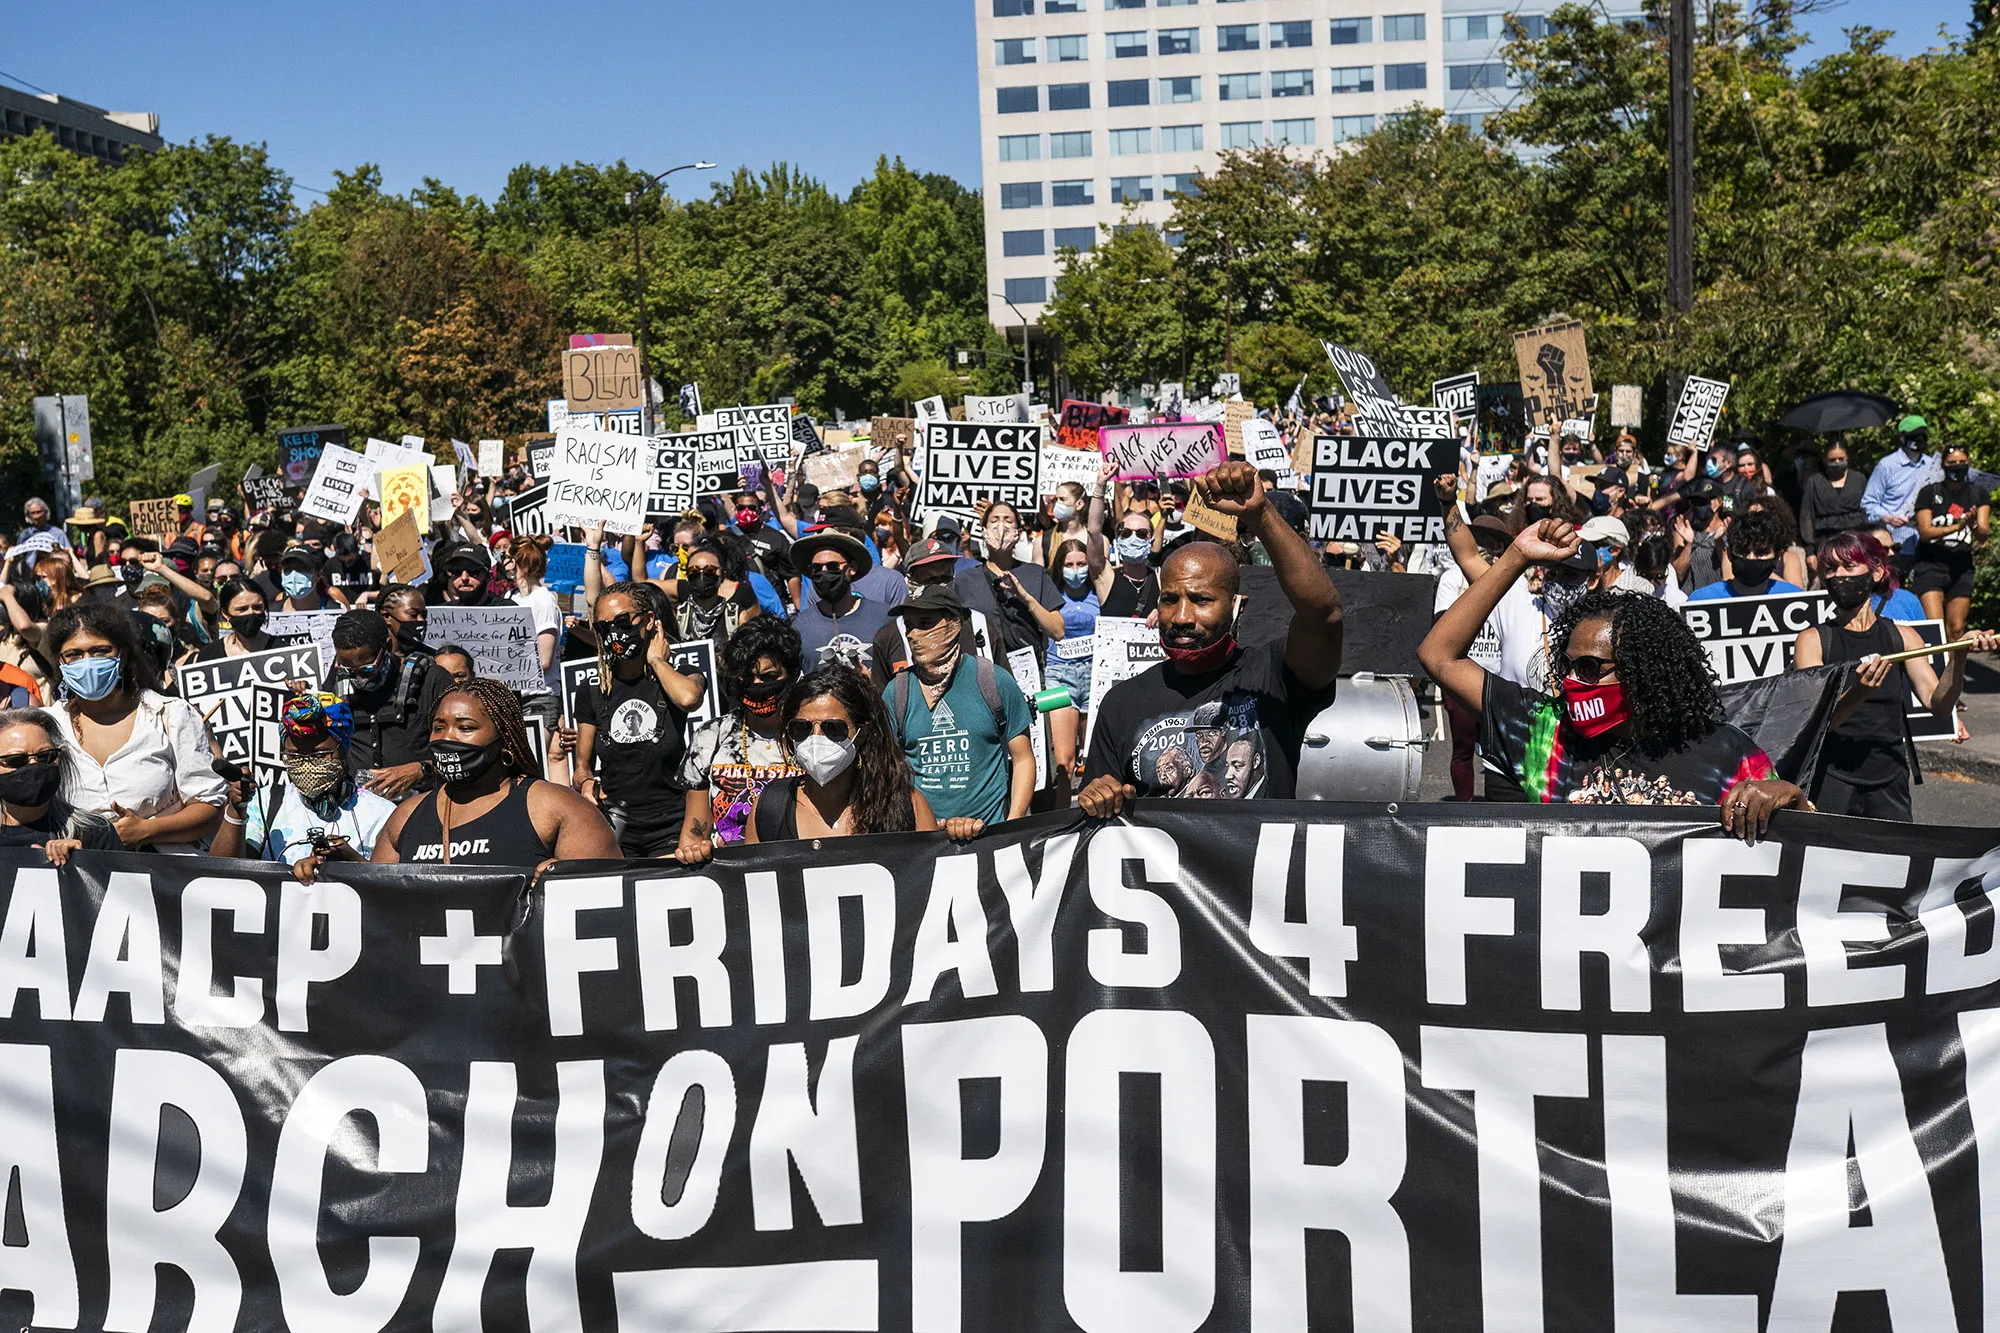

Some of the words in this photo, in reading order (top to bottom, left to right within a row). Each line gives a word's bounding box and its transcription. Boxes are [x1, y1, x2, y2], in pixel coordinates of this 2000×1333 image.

[1326, 343, 1376, 380] COVID
[569, 352, 639, 401] BLM
[1350, 376, 1362, 393] IS
[1367, 381, 1378, 396] A
[1436, 384, 1475, 411] VOTE
[978, 398, 1015, 416] STOP
[1671, 380, 1699, 440] BLACK
[1684, 385, 1711, 440] LIVES
[595, 415, 640, 435] VOTE
[719, 408, 787, 427] BLACK
[872, 418, 912, 432] BLACK
[1402, 411, 1448, 425] ACK
[1698, 386, 1724, 447] MATTER
[283, 432, 319, 448] KEEP
[659, 432, 731, 451] RACISM
[738, 426, 786, 445] IVES
[872, 438, 895, 446] MATT
[930, 427, 1037, 450] BLACK
[567, 437, 637, 470] RACISM
[738, 444, 789, 461] ATTER
[1043, 453, 1061, 461] WE
[1143, 431, 1178, 476] LIVES
[1257, 449, 1283, 460] LIVES
[1316, 439, 1434, 468] BLACK
[336, 460, 357, 473] BLACK
[590, 468, 603, 481] IS
[933, 454, 1033, 480] LIVES
[1061, 463, 1100, 473] TREND
[243, 478, 281, 494] BLACK
[325, 478, 353, 494] LIVES
[1317, 478, 1416, 504] LIVES
[256, 497, 297, 509] MATTER
[553, 479, 642, 515] TERRORISM
[928, 484, 1034, 507] MATTER
[139, 502, 176, 513] FUCK
[314, 497, 350, 513] MATTER
[133, 512, 174, 526] POLICE
[607, 520, 637, 532] POLICE
[134, 521, 181, 537] BRUTALITY
[1309, 514, 1447, 542] MATTER
[385, 545, 397, 559] NO
[1686, 600, 1837, 638] BLACK
[289, 635, 312, 645] ACK
[428, 630, 446, 640] and
[453, 630, 488, 641] Justice
[491, 631, 505, 640] for
[1128, 644, 1166, 659] BLACK
[186, 650, 316, 697] BLACK
[618, 705, 628, 715] ALL
[631, 702, 650, 713] POWER
[1565, 697, 1605, 722] LAND
[1230, 714, 1248, 730] 28
[613, 730, 621, 738] TO
[1149, 731, 1185, 751] 2020
[920, 738, 969, 755] ZERO
[1132, 743, 1143, 778] AUGUST
[1164, 719, 1186, 727] 1963
[921, 753, 970, 764] LANDFILL
[712, 764, 751, 780] TAKE
[755, 765, 765, 779] A
[920, 764, 970, 774] SEATTLE
[412, 845, 445, 860] JUST
[449, 840, 470, 857] DO
[472, 838, 490, 854] IT.
[0, 867, 363, 1032] AACP
[543, 824, 1181, 1037] FRIDAYS
[1248, 823, 1358, 997] 4
[630, 1033, 863, 1241] ON
